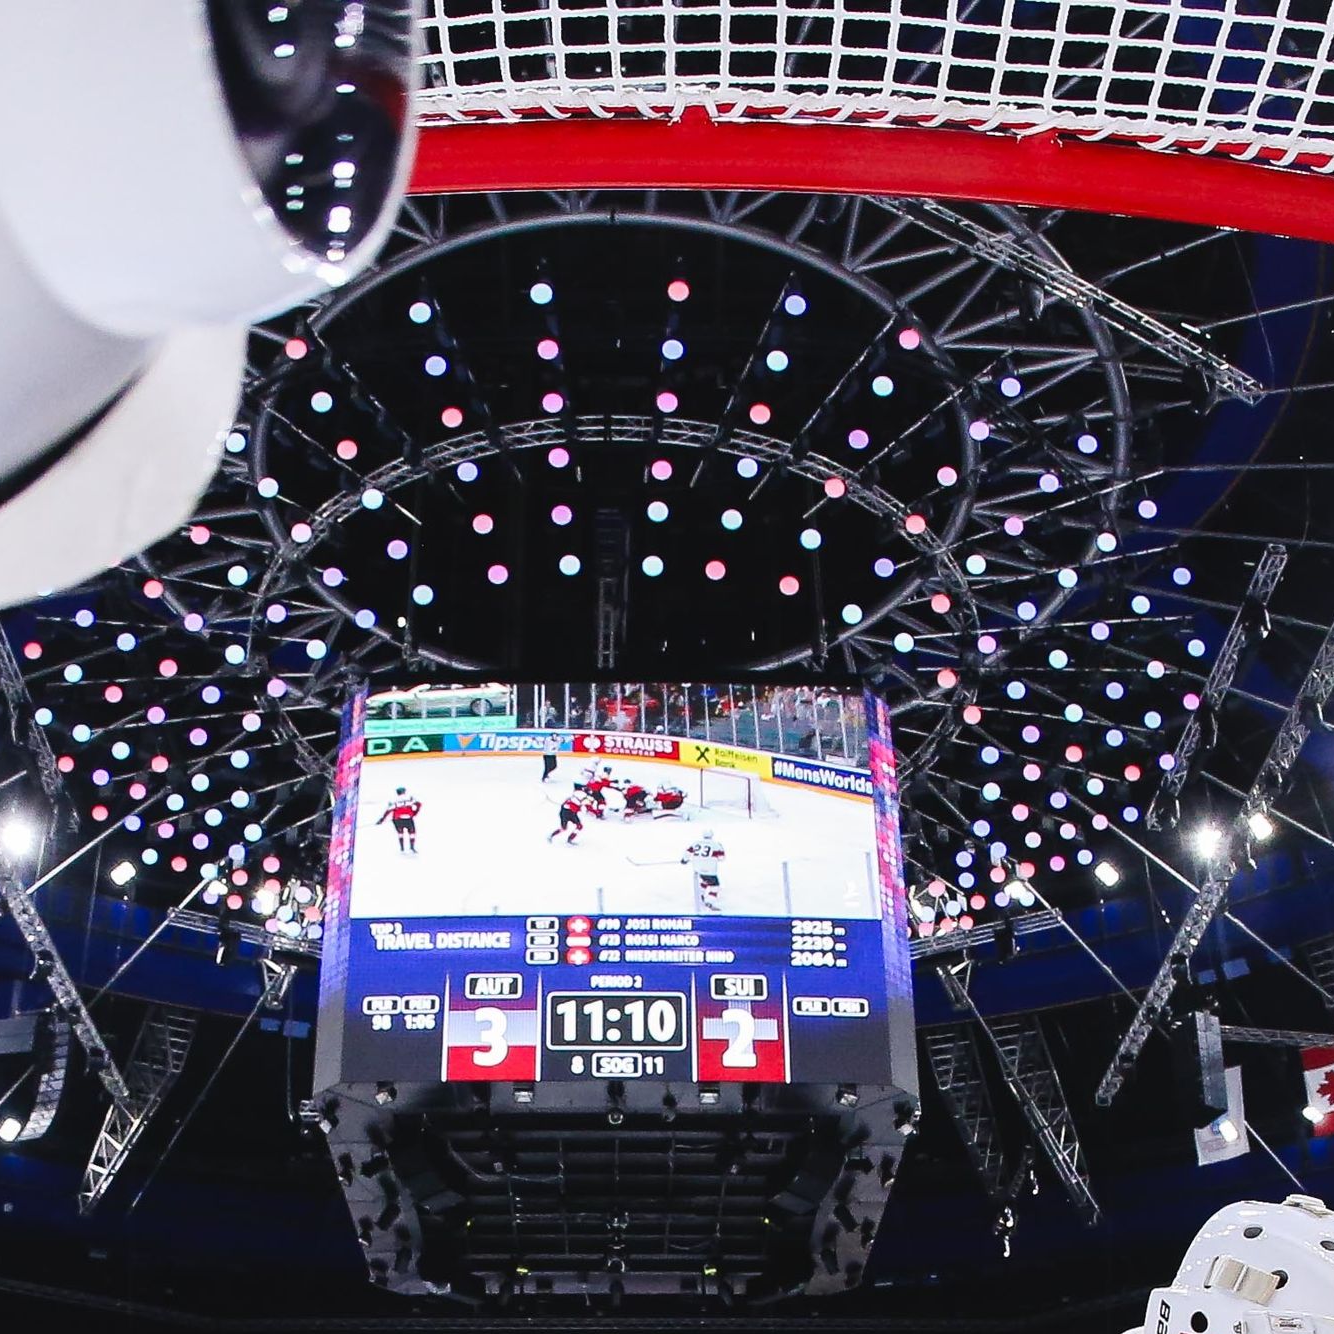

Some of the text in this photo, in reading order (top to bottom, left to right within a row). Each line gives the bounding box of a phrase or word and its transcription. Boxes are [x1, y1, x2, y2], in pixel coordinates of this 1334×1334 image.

[604, 736, 673, 754] STRAUSS
[715, 748, 758, 763] Raiffeisen
[694, 844, 712, 857] 23
[791, 920, 833, 934] 2925
[375, 931, 511, 950] TRAVEL DISTANCE
[624, 933, 659, 947] ROSSI
[660, 933, 700, 947] MARCO
[790, 936, 834, 950] 2239
[475, 977, 514, 996] AUT
[590, 975, 643, 988] PERIOD 2
[724, 978, 755, 997] SUI
[556, 999, 677, 1042] 11:10
[472, 1007, 509, 1066] 3
[722, 1008, 757, 1068] 2
[570, 1056, 585, 1075] 8
[599, 1057, 635, 1074] SOG
[643, 1056, 664, 1075] 11
